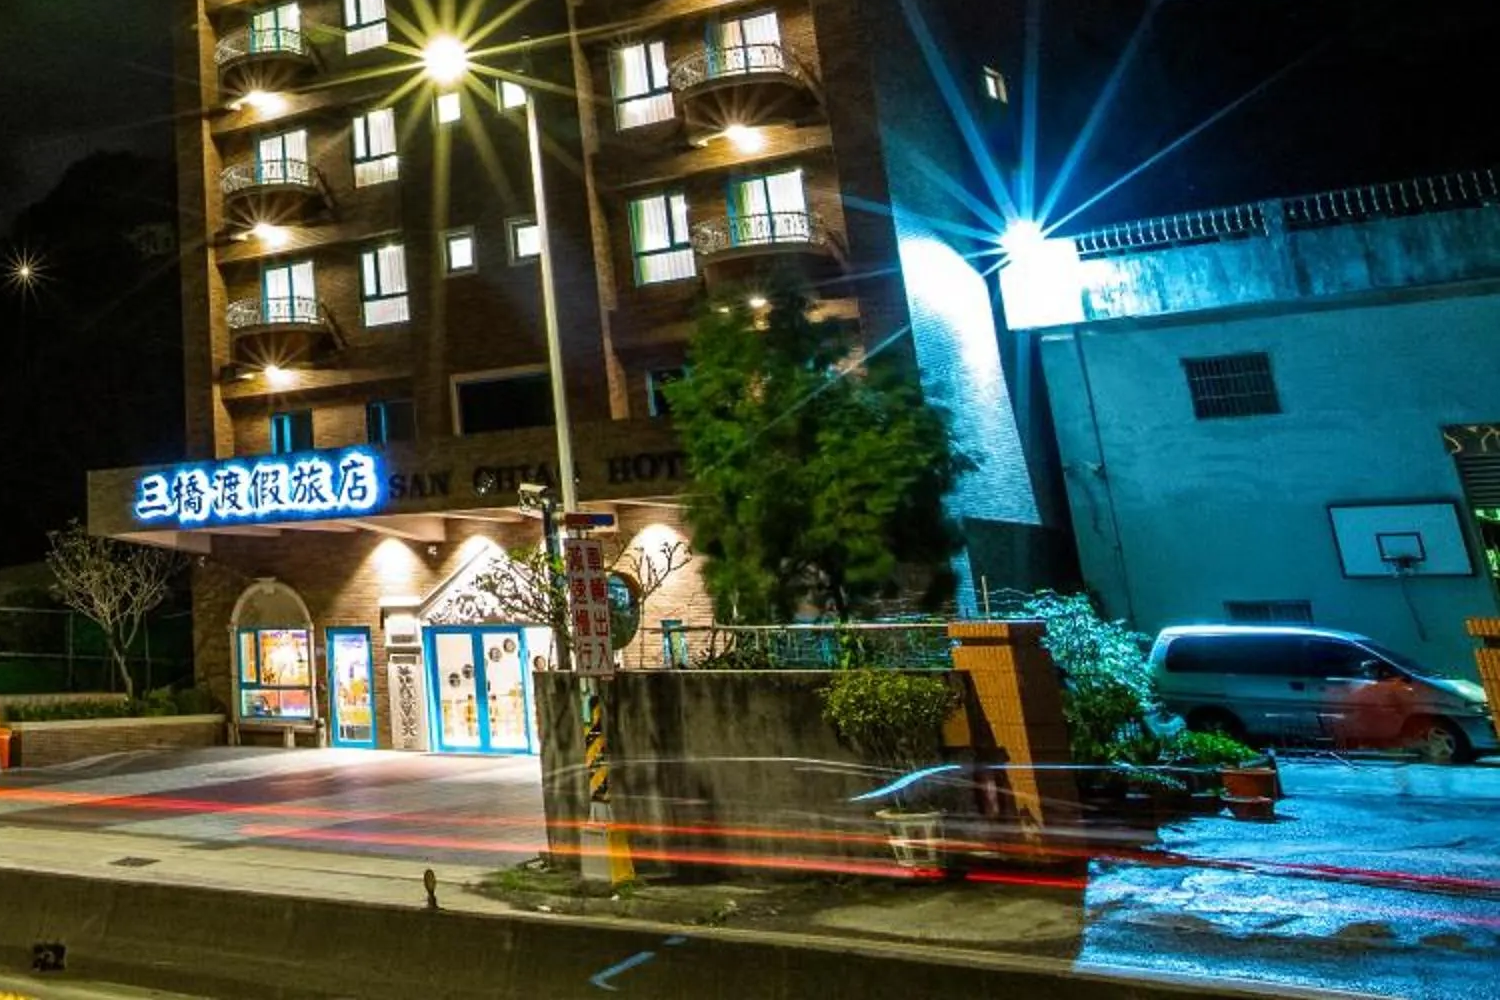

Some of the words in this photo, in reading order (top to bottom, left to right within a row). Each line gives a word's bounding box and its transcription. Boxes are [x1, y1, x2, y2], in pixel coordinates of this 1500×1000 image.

[137, 459, 369, 515] 三橋渡假旅店
[388, 469, 452, 499] SAN
[472, 460, 581, 496] CHIA
[608, 451, 686, 484] HOT
